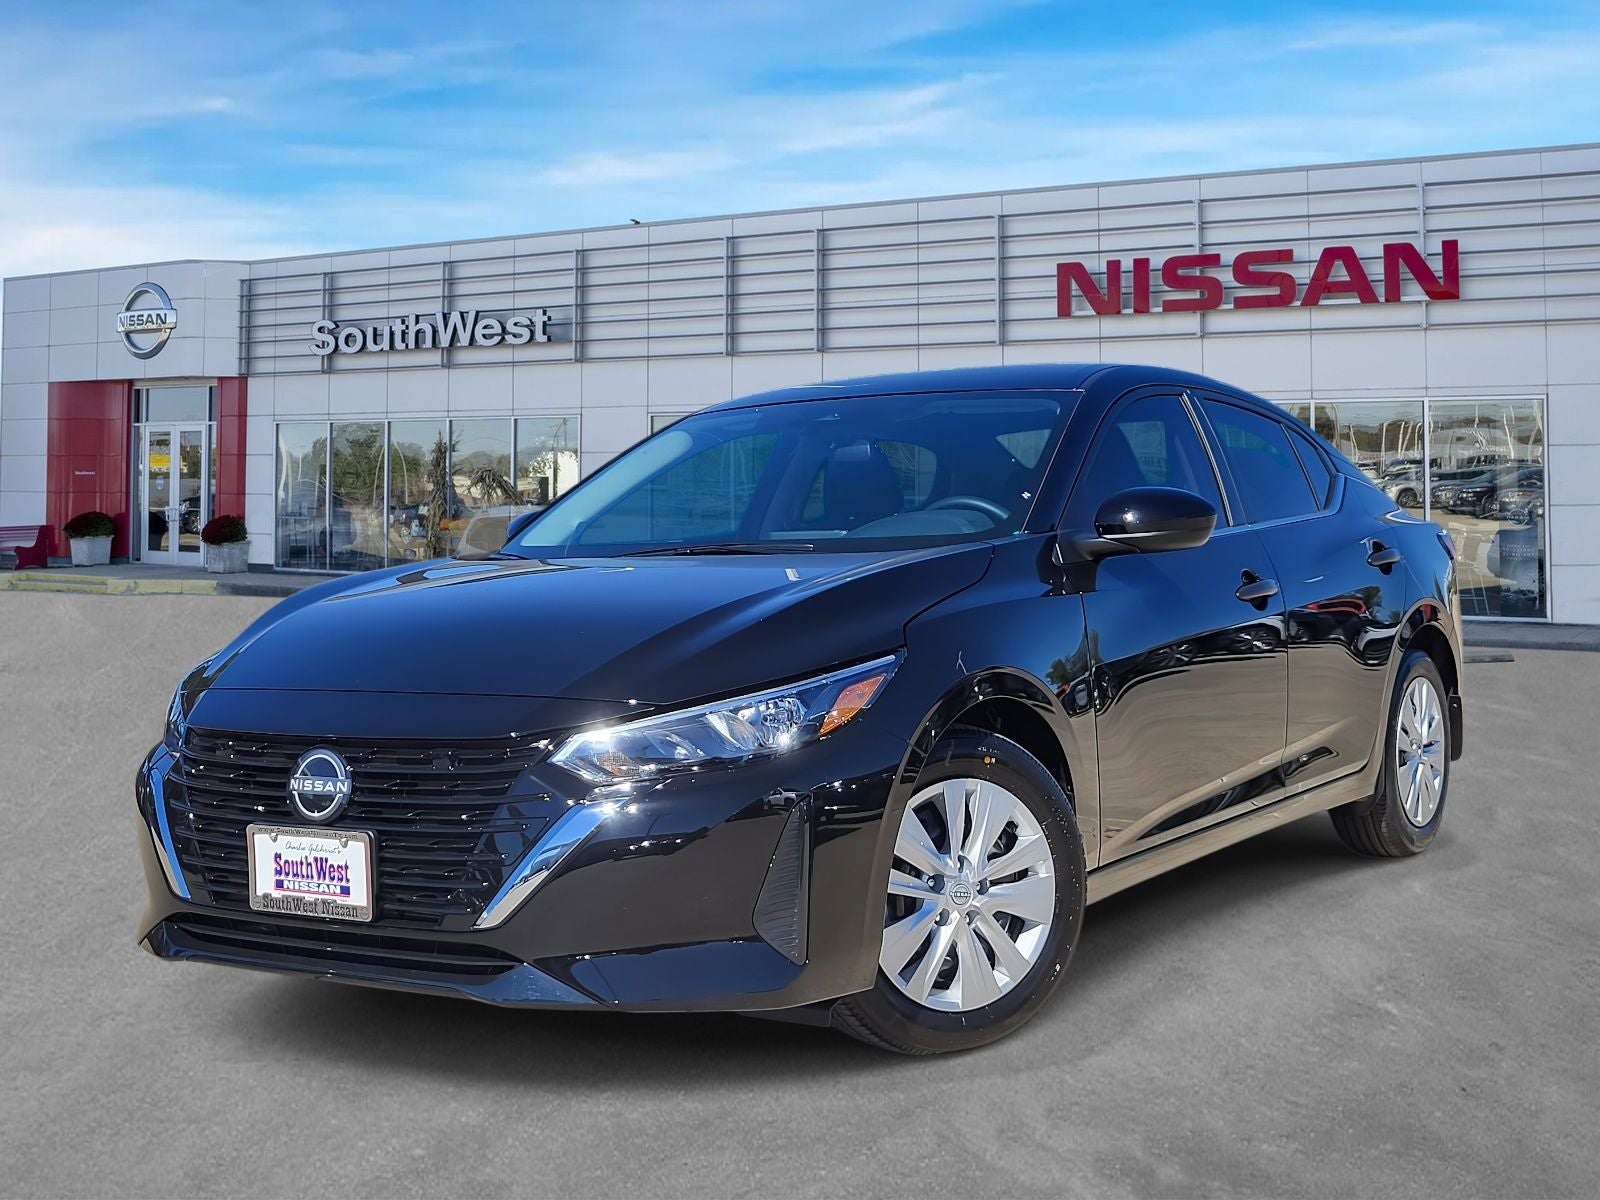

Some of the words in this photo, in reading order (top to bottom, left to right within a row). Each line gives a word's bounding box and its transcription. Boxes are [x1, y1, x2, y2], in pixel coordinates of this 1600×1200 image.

[1056, 239, 1460, 318] NISSAN
[119, 312, 167, 328] NISSAN
[308, 308, 552, 356] SouthWest
[290, 778, 349, 793] NISSAN
[274, 851, 350, 884] SouthWest
[283, 880, 341, 894] NISSAN
[262, 894, 320, 915] SouthWest
[321, 898, 359, 918] Nissan
